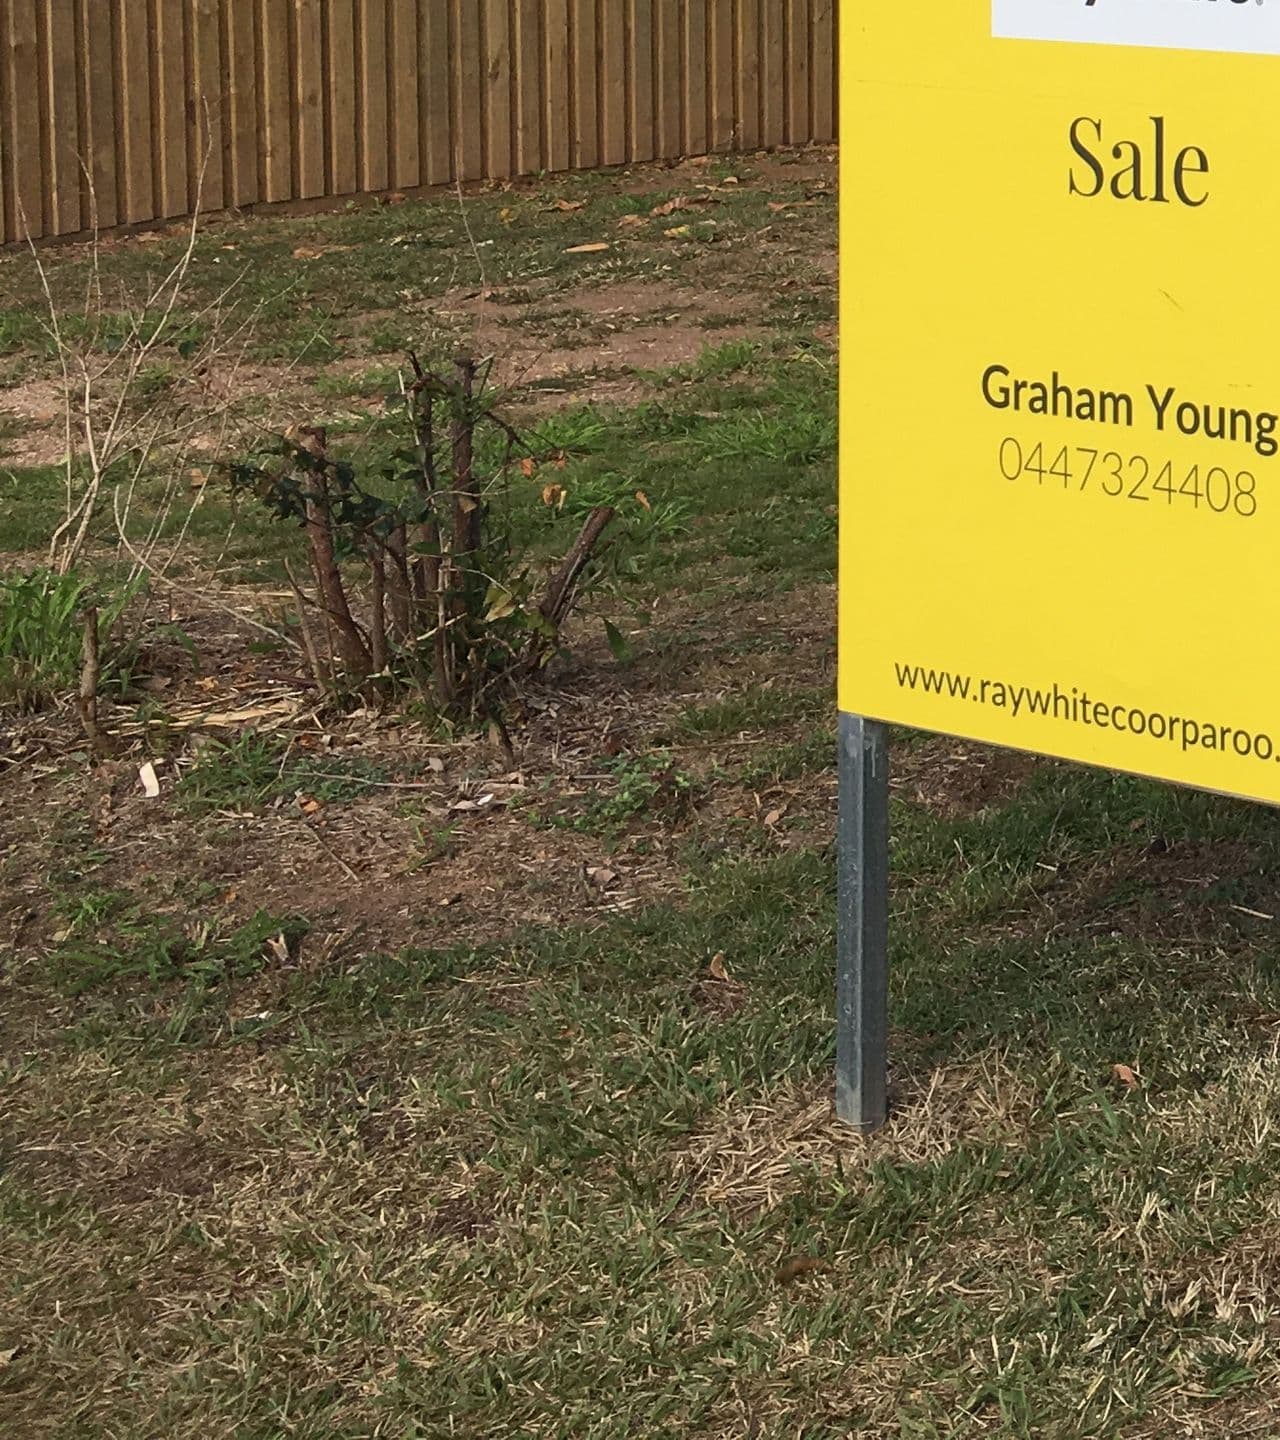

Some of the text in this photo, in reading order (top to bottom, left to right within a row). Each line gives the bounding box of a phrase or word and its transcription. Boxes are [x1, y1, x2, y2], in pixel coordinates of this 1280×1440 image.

[1069, 116, 1210, 207] Sale
[982, 364, 1280, 456] Graham Young
[999, 436, 1257, 516] 0447324408
